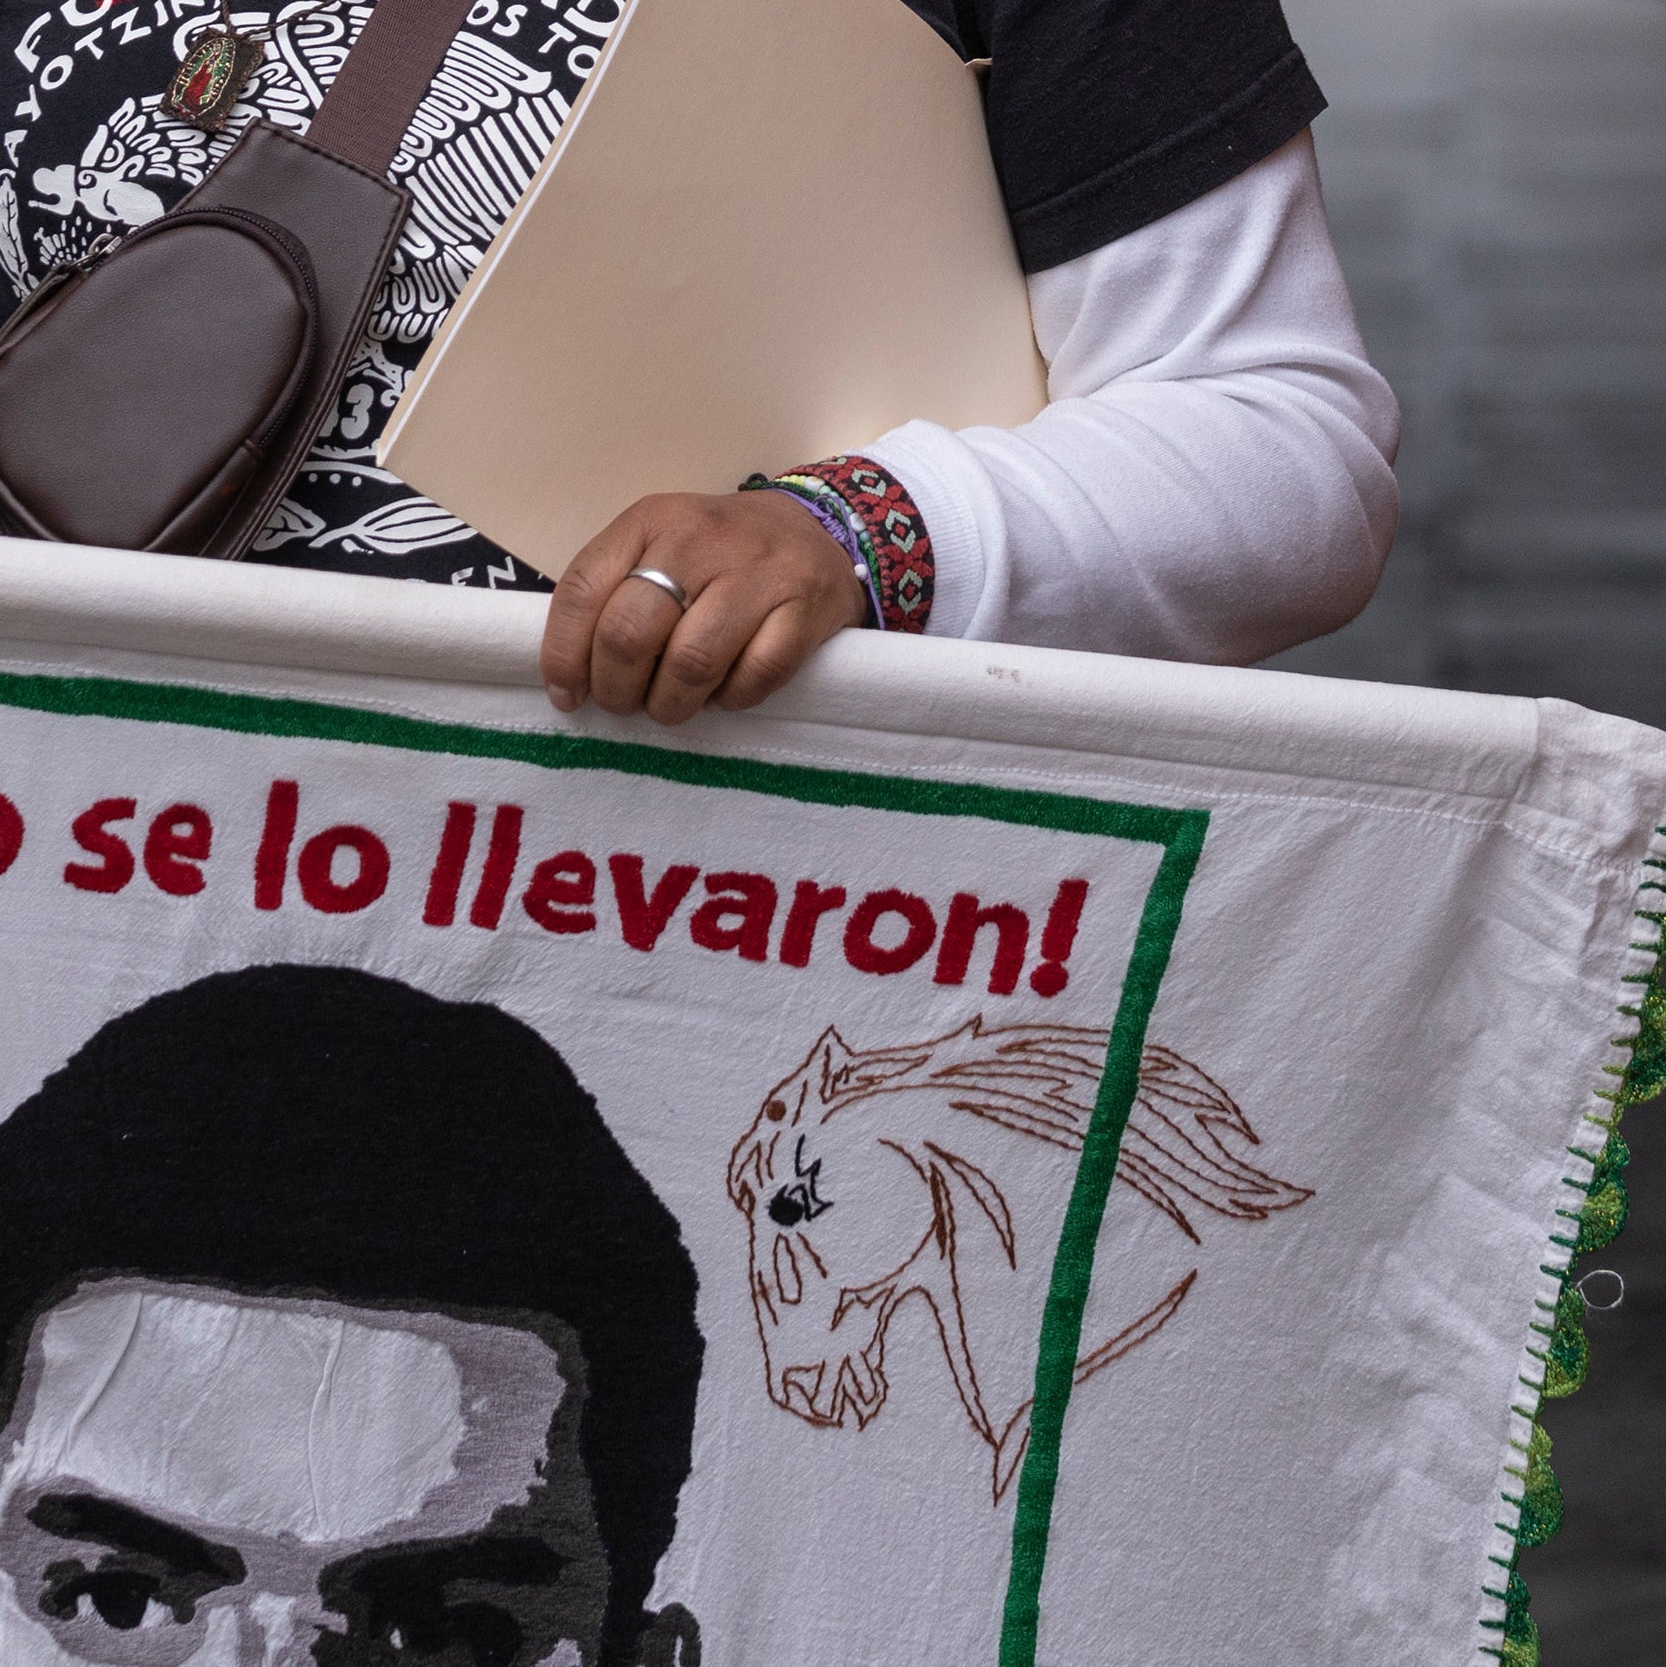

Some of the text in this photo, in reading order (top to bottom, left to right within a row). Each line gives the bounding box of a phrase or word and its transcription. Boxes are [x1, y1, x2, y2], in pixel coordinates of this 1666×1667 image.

[64, 796, 214, 896] se
[254, 780, 391, 914] lo
[422, 799, 1091, 998] llevaron!
